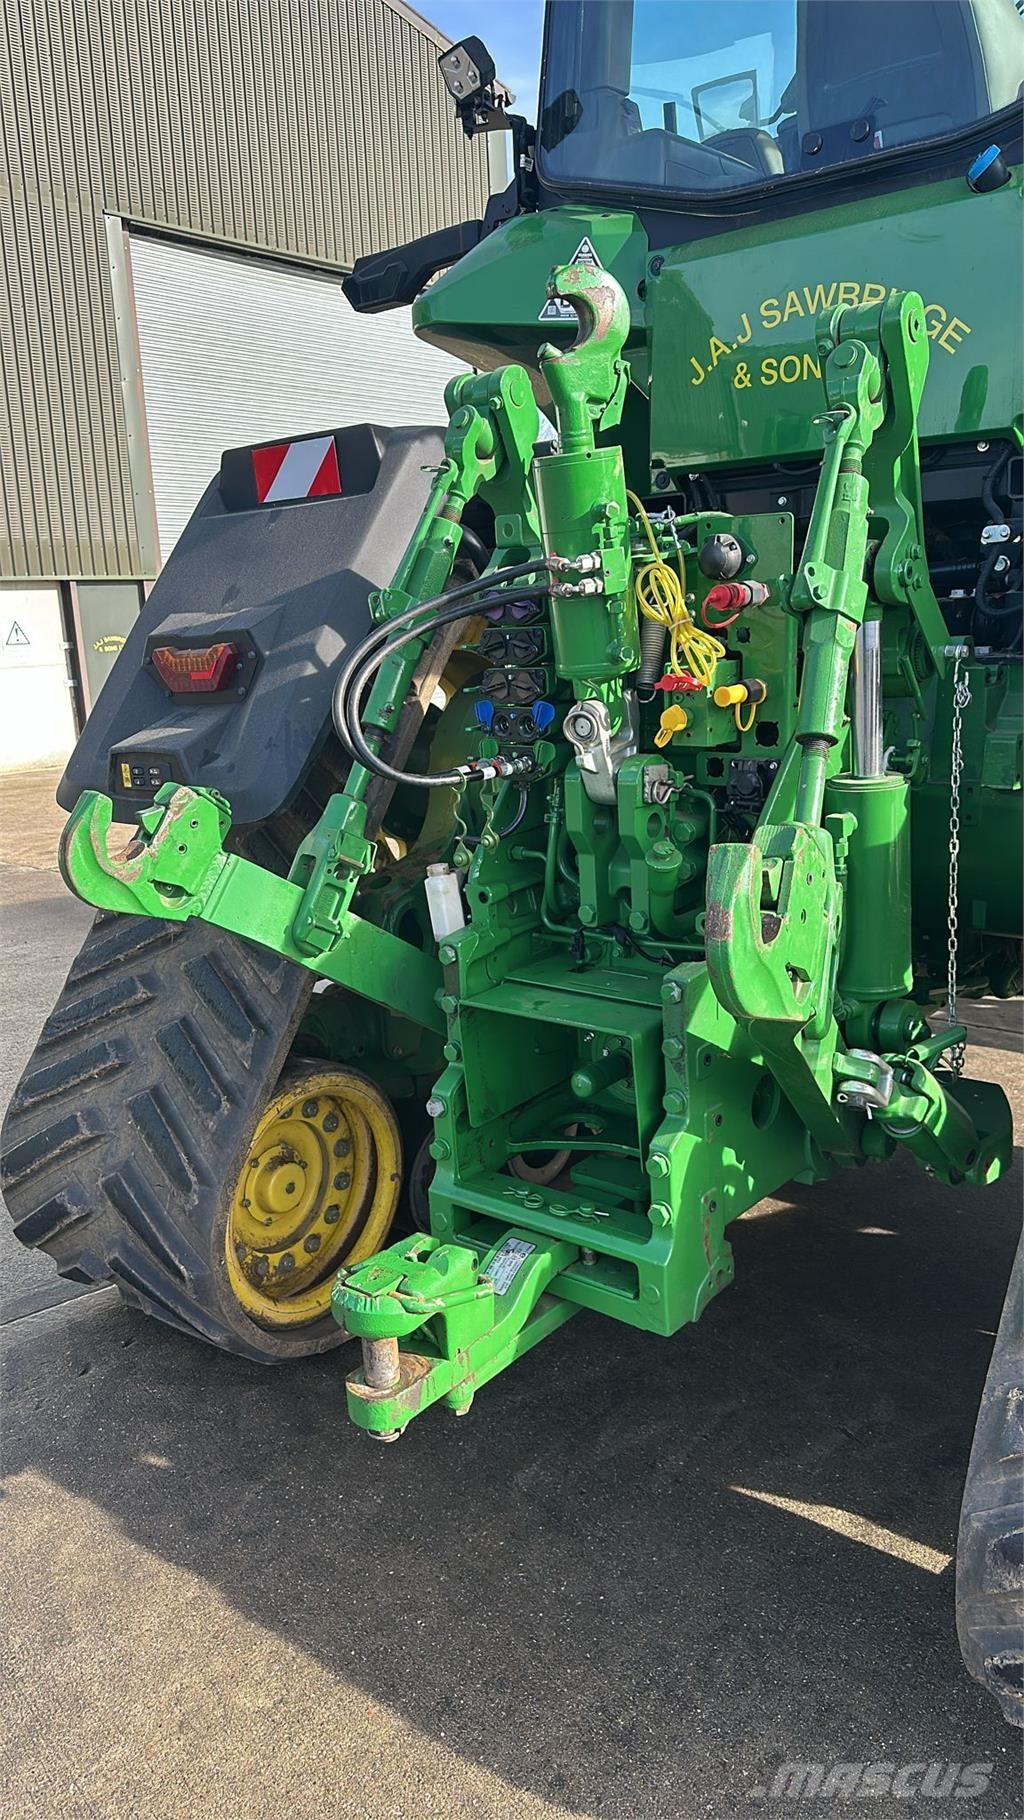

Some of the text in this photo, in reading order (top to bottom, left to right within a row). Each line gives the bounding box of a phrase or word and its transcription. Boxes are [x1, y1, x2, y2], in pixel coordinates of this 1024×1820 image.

[690, 282, 972, 385] J.A.J SAWBRGE
[734, 362, 752, 389] &
